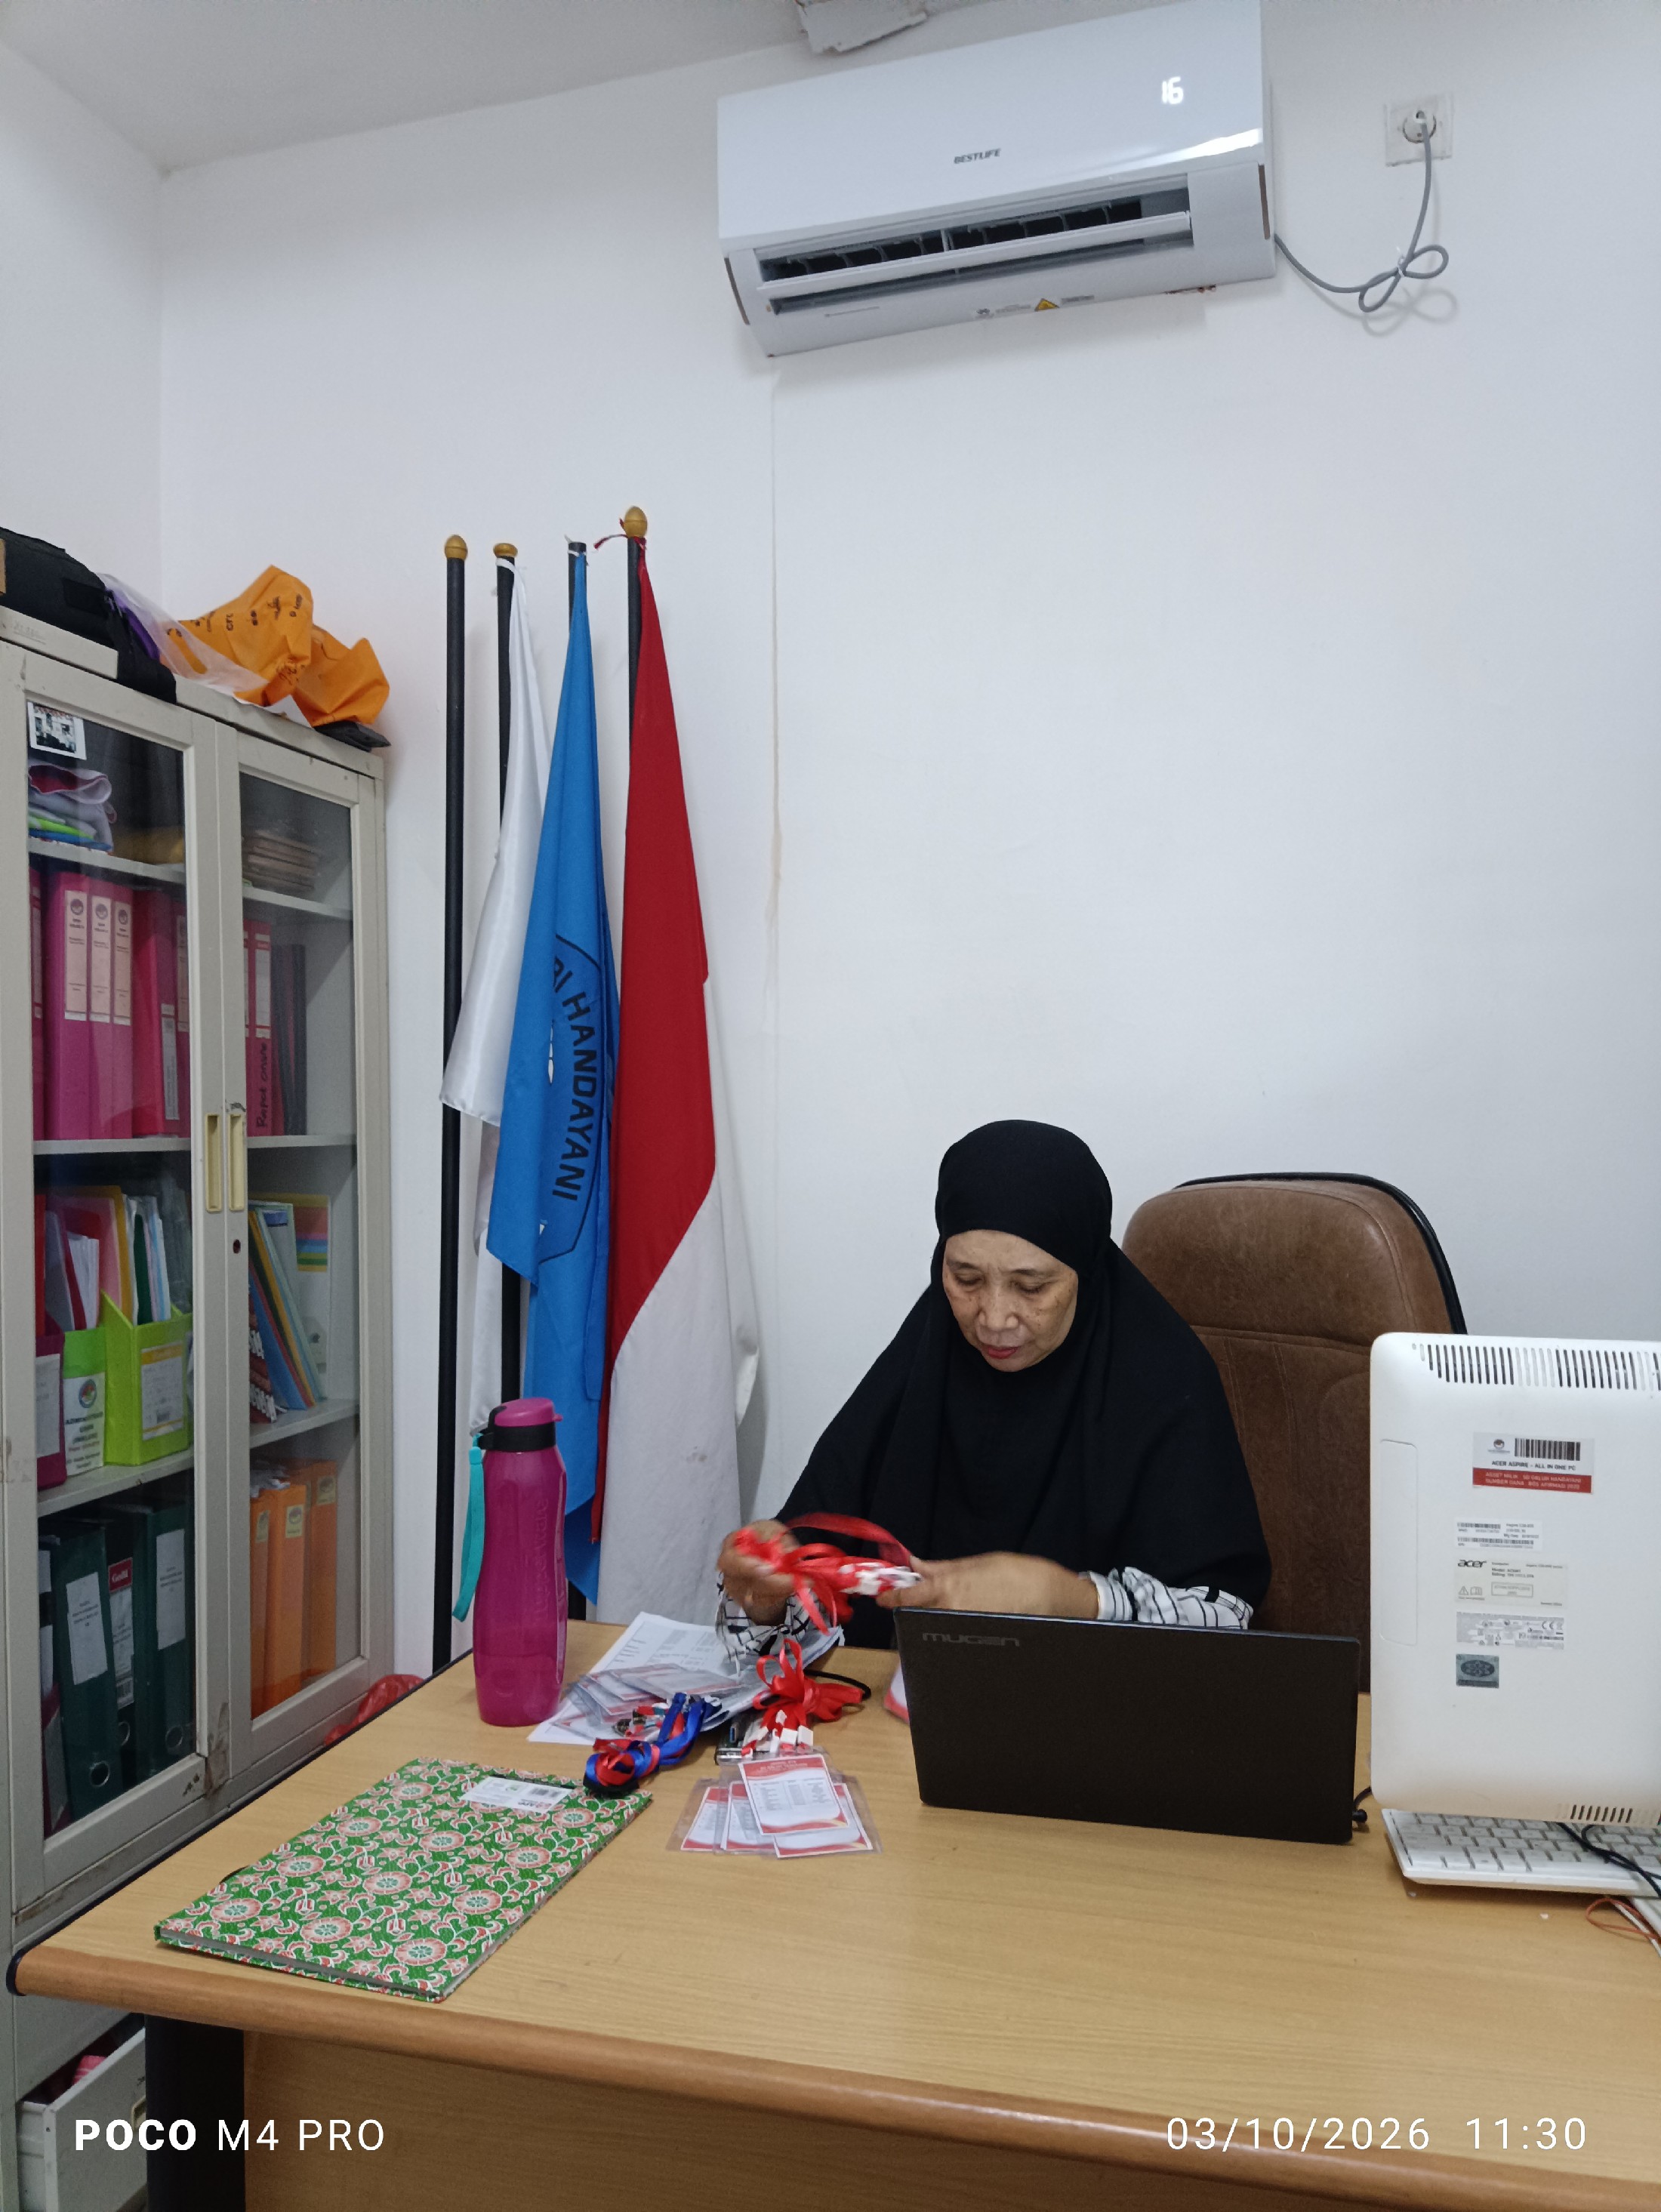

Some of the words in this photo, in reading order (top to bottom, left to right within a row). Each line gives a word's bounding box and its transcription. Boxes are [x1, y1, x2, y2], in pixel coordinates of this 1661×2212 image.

[1161, 76, 1184, 104] 16
[954, 147, 1001, 164] BESTLIFE
[552, 991, 597, 1202] HANDAYANI
[1457, 1559, 1487, 1568] acer
